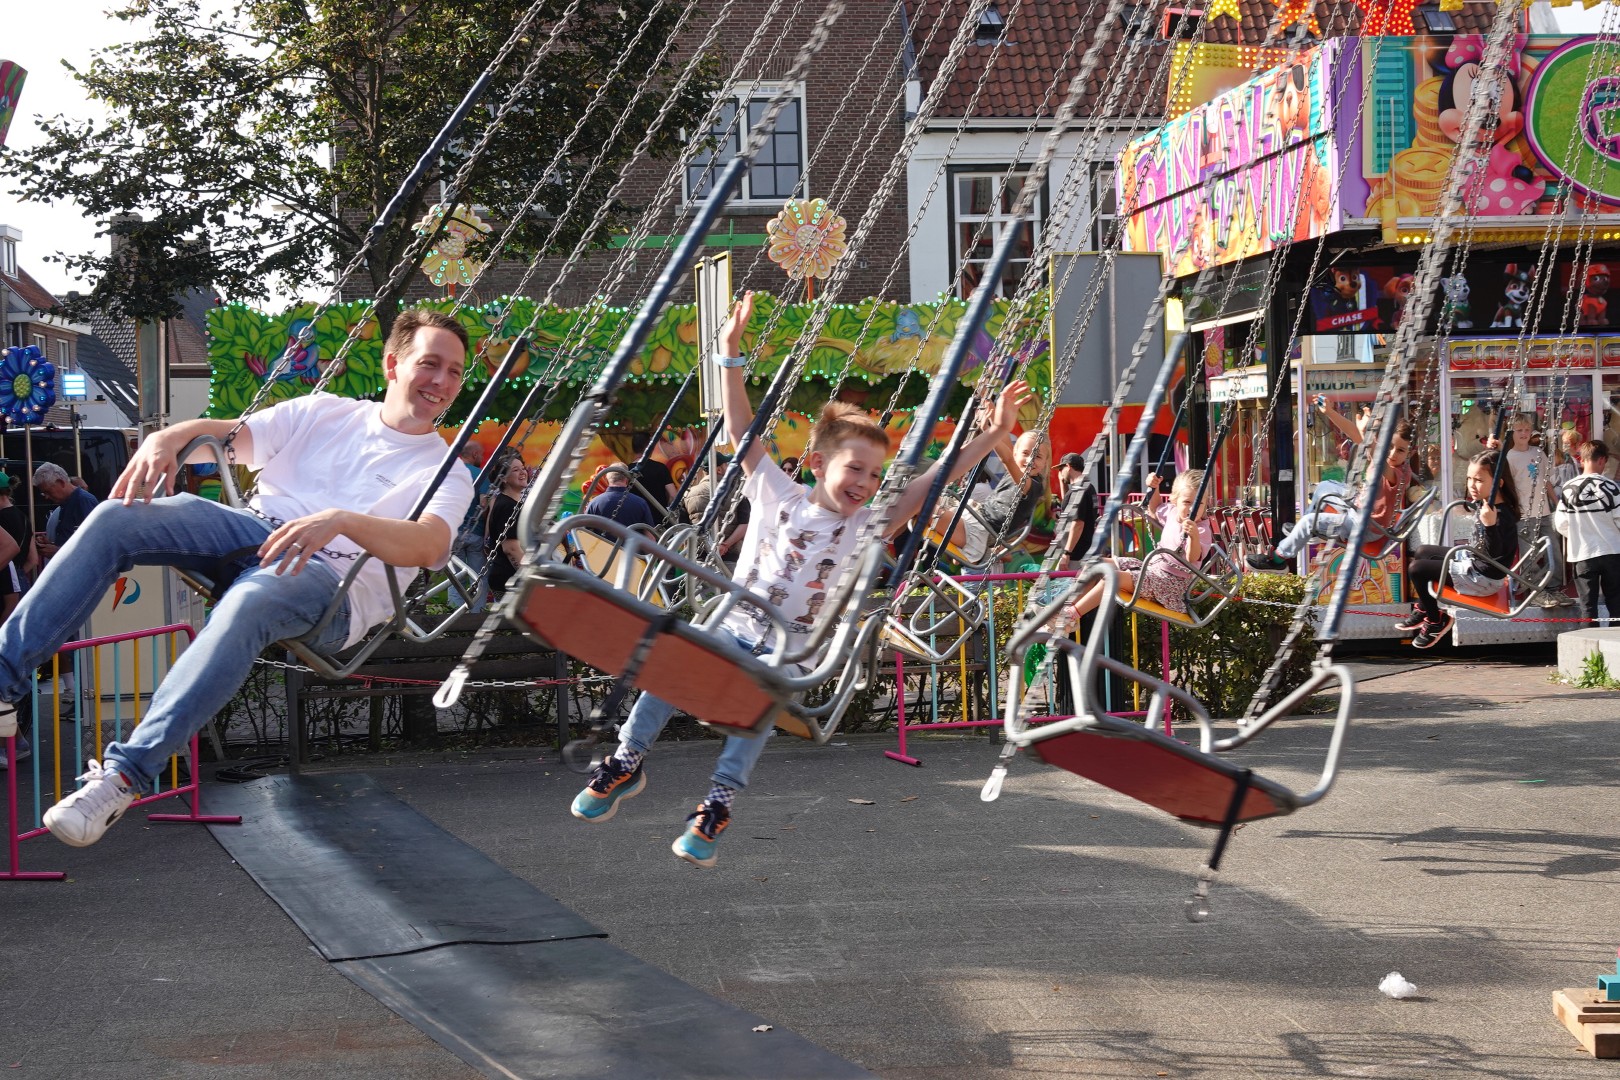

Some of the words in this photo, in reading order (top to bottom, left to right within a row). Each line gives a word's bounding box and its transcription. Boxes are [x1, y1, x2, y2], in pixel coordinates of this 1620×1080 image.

[1332, 312, 1363, 326] CHASE
[1451, 343, 1518, 369] GIGA
[1527, 341, 1595, 367] GIGA
